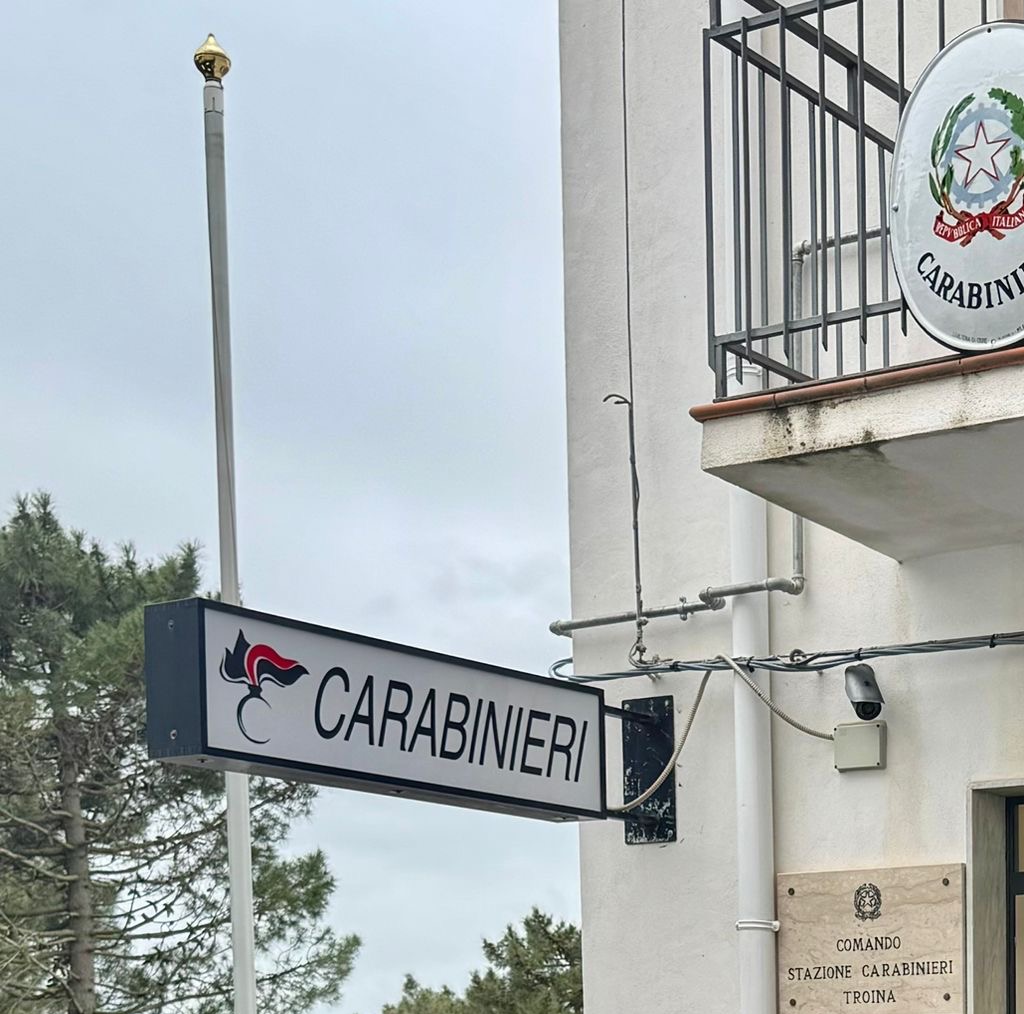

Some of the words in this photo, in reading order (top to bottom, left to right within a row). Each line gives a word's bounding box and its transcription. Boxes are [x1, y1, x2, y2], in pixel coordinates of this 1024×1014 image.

[314, 666, 589, 783] CARABINIERI
[836, 936, 901, 952] COMANDO
[788, 965, 852, 981] STAZIONE
[862, 960, 953, 978] CARABINIERI
[843, 989, 896, 1004] TROINA
